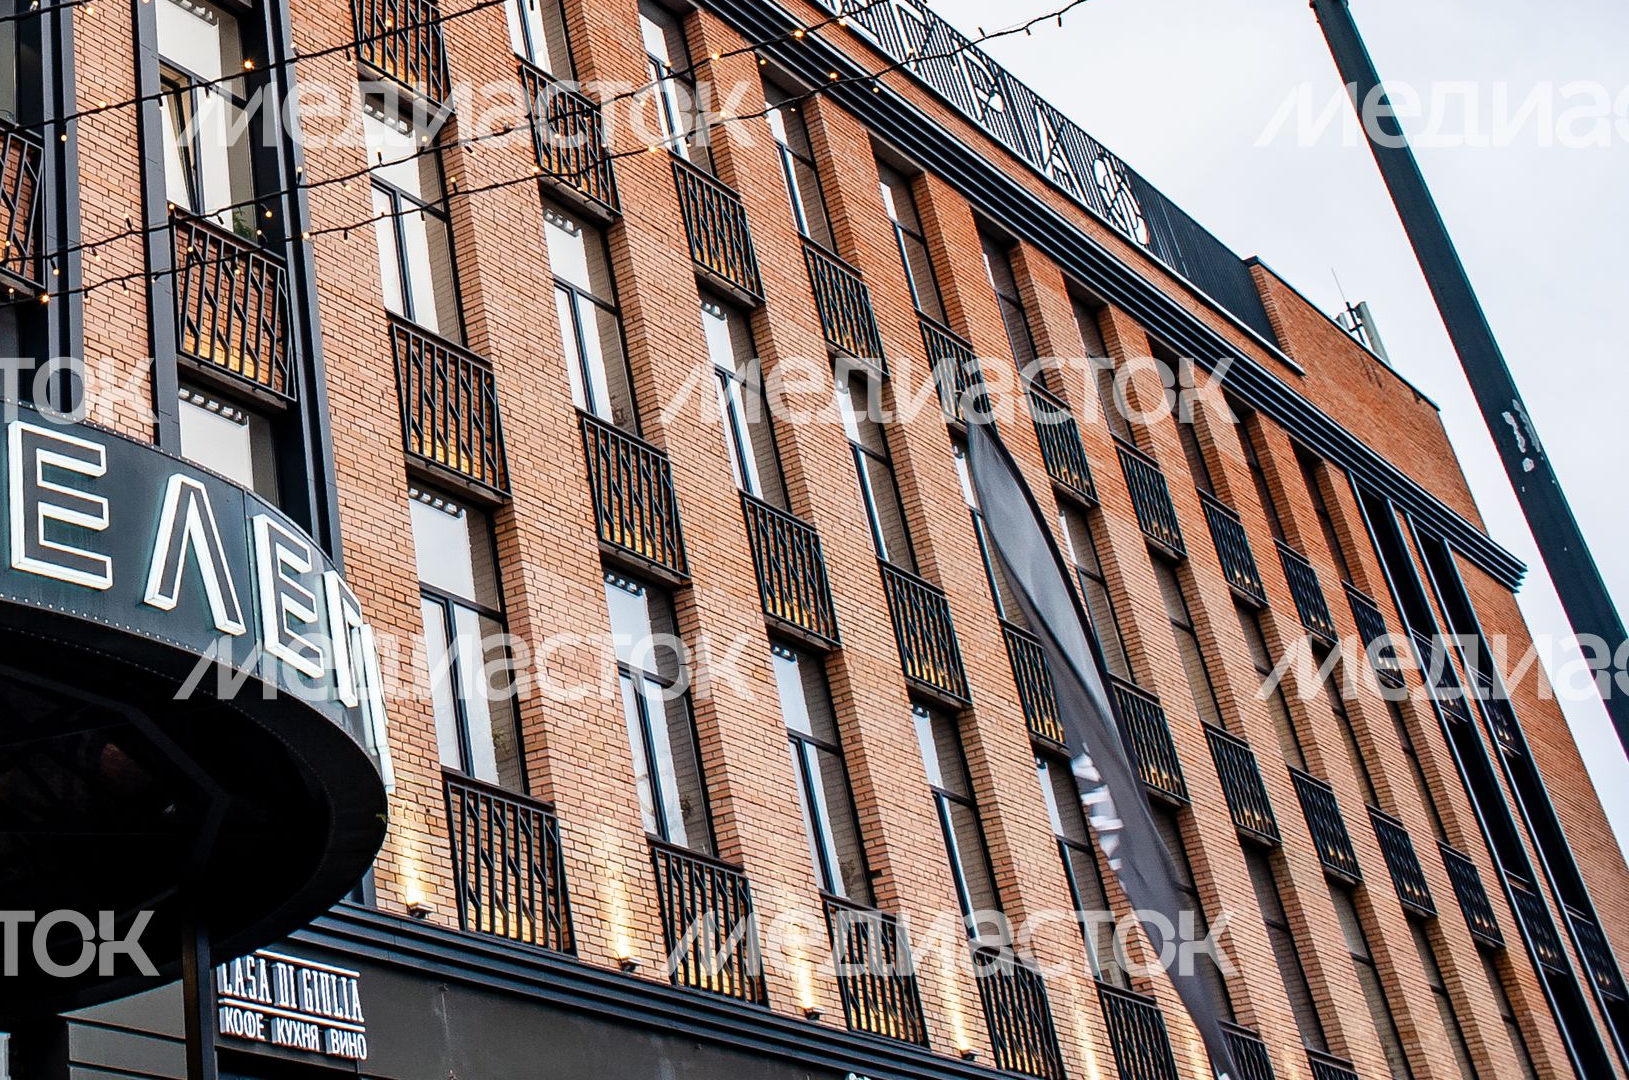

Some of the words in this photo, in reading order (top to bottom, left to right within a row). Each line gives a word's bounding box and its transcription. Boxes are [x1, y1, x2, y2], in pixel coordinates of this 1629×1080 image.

[273, 961, 299, 1009] DI
[219, 1006, 266, 1041] КОФЕ
[273, 1016, 321, 1052] КУХНЯ
[325, 1027, 369, 1061] ВИНО
